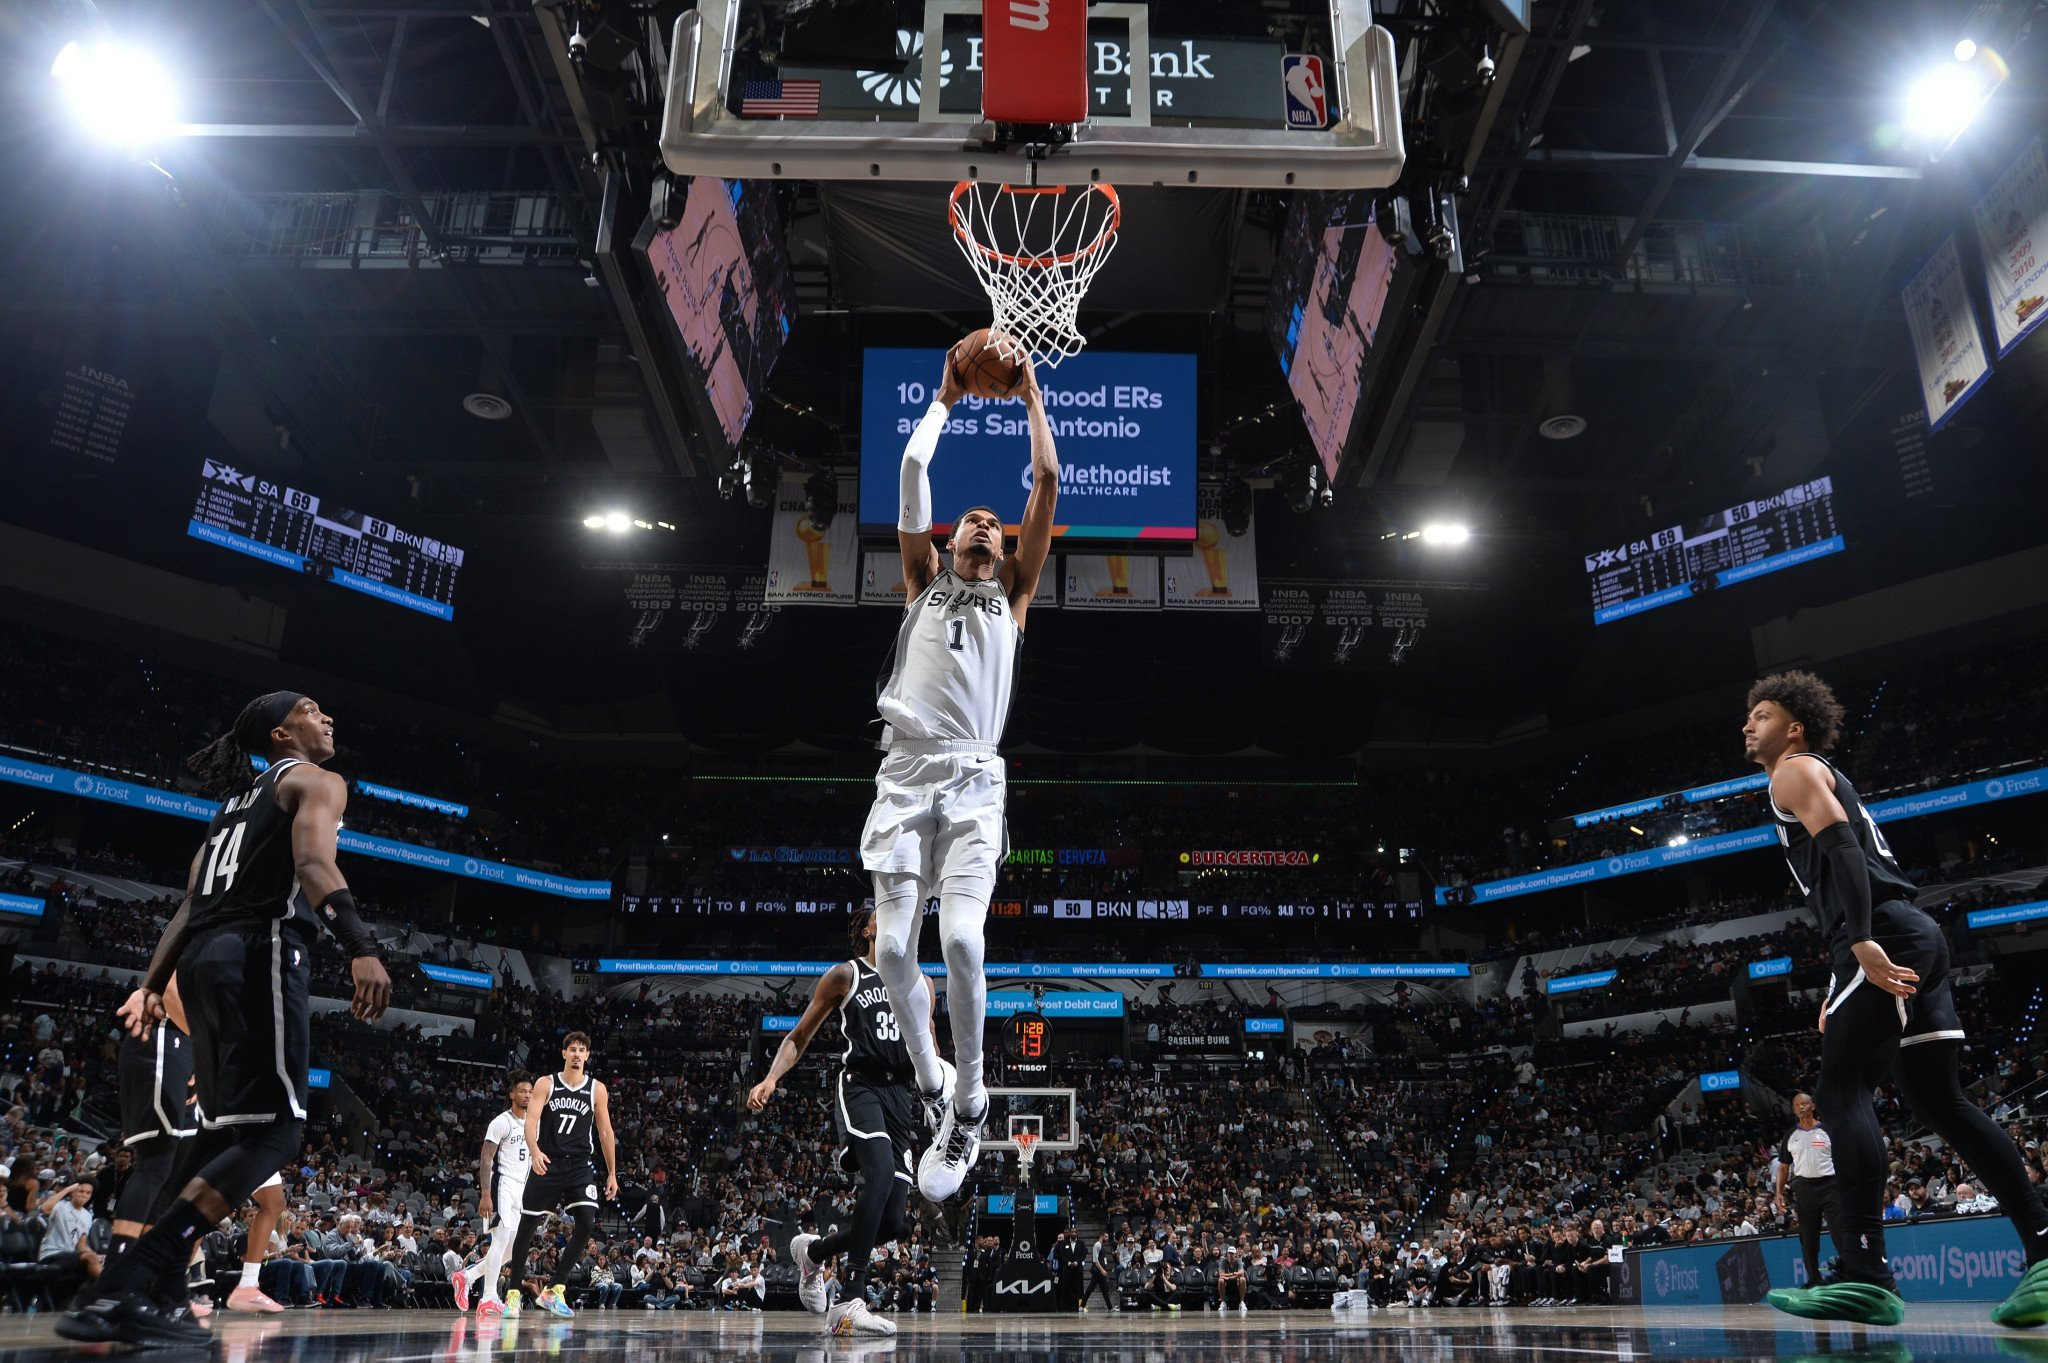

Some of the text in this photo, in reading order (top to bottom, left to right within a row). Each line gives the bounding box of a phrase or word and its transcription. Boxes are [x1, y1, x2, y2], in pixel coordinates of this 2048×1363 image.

[1292, 109, 1312, 124] NBA
[2012, 255, 2035, 284] 2010
[897, 382, 925, 404] 10
[1113, 386, 1163, 409] ERs
[984, 413, 1031, 436] San
[1045, 414, 1140, 437] Antonio
[1058, 464, 1171, 486] Methodist
[258, 481, 278, 500] SA
[209, 494, 233, 508] CASTLE
[291, 492, 312, 511] 69
[1757, 492, 1785, 514] BKN
[208, 502, 235, 517] VASSELL
[1731, 505, 1750, 523] 50
[208, 517, 230, 531] BARNES
[370, 521, 389, 539] 50
[198, 526, 295, 565] Where fans score more
[395, 529, 422, 551] BKN
[1658, 529, 1676, 548] 69
[370, 549, 392, 563] PORTER
[372, 542, 389, 554] MANN
[1630, 540, 1648, 556] SA
[368, 556, 391, 570] WILSON
[1727, 541, 1835, 581] FrostBank.com/SpursCard
[367, 564, 392, 578] CLAXTON
[640, 575, 671, 583] NBA
[694, 575, 727, 584] NBA
[343, 575, 444, 615] FrostBank.com/SpursCard
[1278, 590, 1310, 599] NBA
[1335, 591, 1367, 599] NBA
[1391, 593, 1423, 602] NBA
[629, 601, 671, 610] 1999
[680, 601, 727, 611] 2003
[736, 602, 782, 612] 2005
[1601, 606, 1625, 620] Where
[1624, 601, 1642, 612] fans
[1267, 615, 1313, 625] 2007
[1325, 616, 1373, 626] 2013
[1382, 618, 1427, 629] 2014
[948, 617, 964, 651] 1
[2005, 775, 2041, 794] Frost
[94, 781, 210, 816] Frost Where fans
[224, 786, 262, 815] MAN
[366, 785, 463, 815] FrostBank.com/SpursCard
[1577, 801, 1657, 826] Where more
[201, 822, 248, 896] 14
[774, 846, 851, 863] GLORIA
[1007, 849, 1106, 865] GARITAS CERVEZA
[1192, 850, 1310, 866] BURGERTECA
[1485, 867, 1595, 898] FrostBank.com/SpursCard
[1624, 856, 1651, 870] Frost
[1662, 846, 1692, 861] Where
[1692, 842, 1714, 855] fans
[1714, 839, 1743, 851] score
[1743, 832, 1769, 845] more
[480, 863, 588, 895] Frost Where fans score
[716, 901, 733, 912] TO
[755, 901, 787, 913] FG%
[819, 902, 837, 913] PF
[990, 904, 1022, 915] 11:29
[1033, 904, 1049, 915] 3RD
[1065, 902, 1081, 916] 50
[1096, 902, 1132, 917] BKN
[1197, 905, 1214, 915] PF
[1241, 905, 1272, 916] FG%
[1278, 905, 1294, 916] 34.0
[1297, 905, 1315, 916] TO
[615, 962, 815, 973] FrostBank.com/SpursCard Frost Where fans
[1043, 966, 1060, 975] Frost
[1072, 966, 1098, 975] Where
[1099, 966, 1117, 975] fans
[1217, 967, 1320, 977] FrostBank.com/SpursCard
[1341, 967, 1359, 976] Frost
[1370, 967, 1396, 975] Where
[1396, 967, 1414, 975] fans
[1767, 962, 1785, 973] Frost
[574, 976, 589, 984] 127
[1199, 981, 1213, 990] 101
[855, 987, 888, 1010] BROO
[994, 1000, 1026, 1012] Spurs
[1063, 999, 1091, 1010] Debit
[1092, 1000, 1118, 1010] Card
[778, 1019, 796, 1027] Frost
[876, 1011, 900, 1042] 33
[1015, 1022, 1044, 1034] 11:28
[1261, 1021, 1278, 1030] Frost
[1022, 1034, 1041, 1057] 13
[1167, 1034, 1230, 1046] BASELINE BUMS
[1017, 1064, 1048, 1072] TISSOT
[549, 1096, 591, 1118] BROOKLYN
[557, 1113, 577, 1135] 77
[518, 1148, 526, 1162] 5
[1015, 1251, 1035, 1260] Frost
[1888, 1243, 2026, 1290] com/Spurs
[1669, 1262, 1700, 1292] Frost
[1618, 1283, 1634, 1299] Frost
